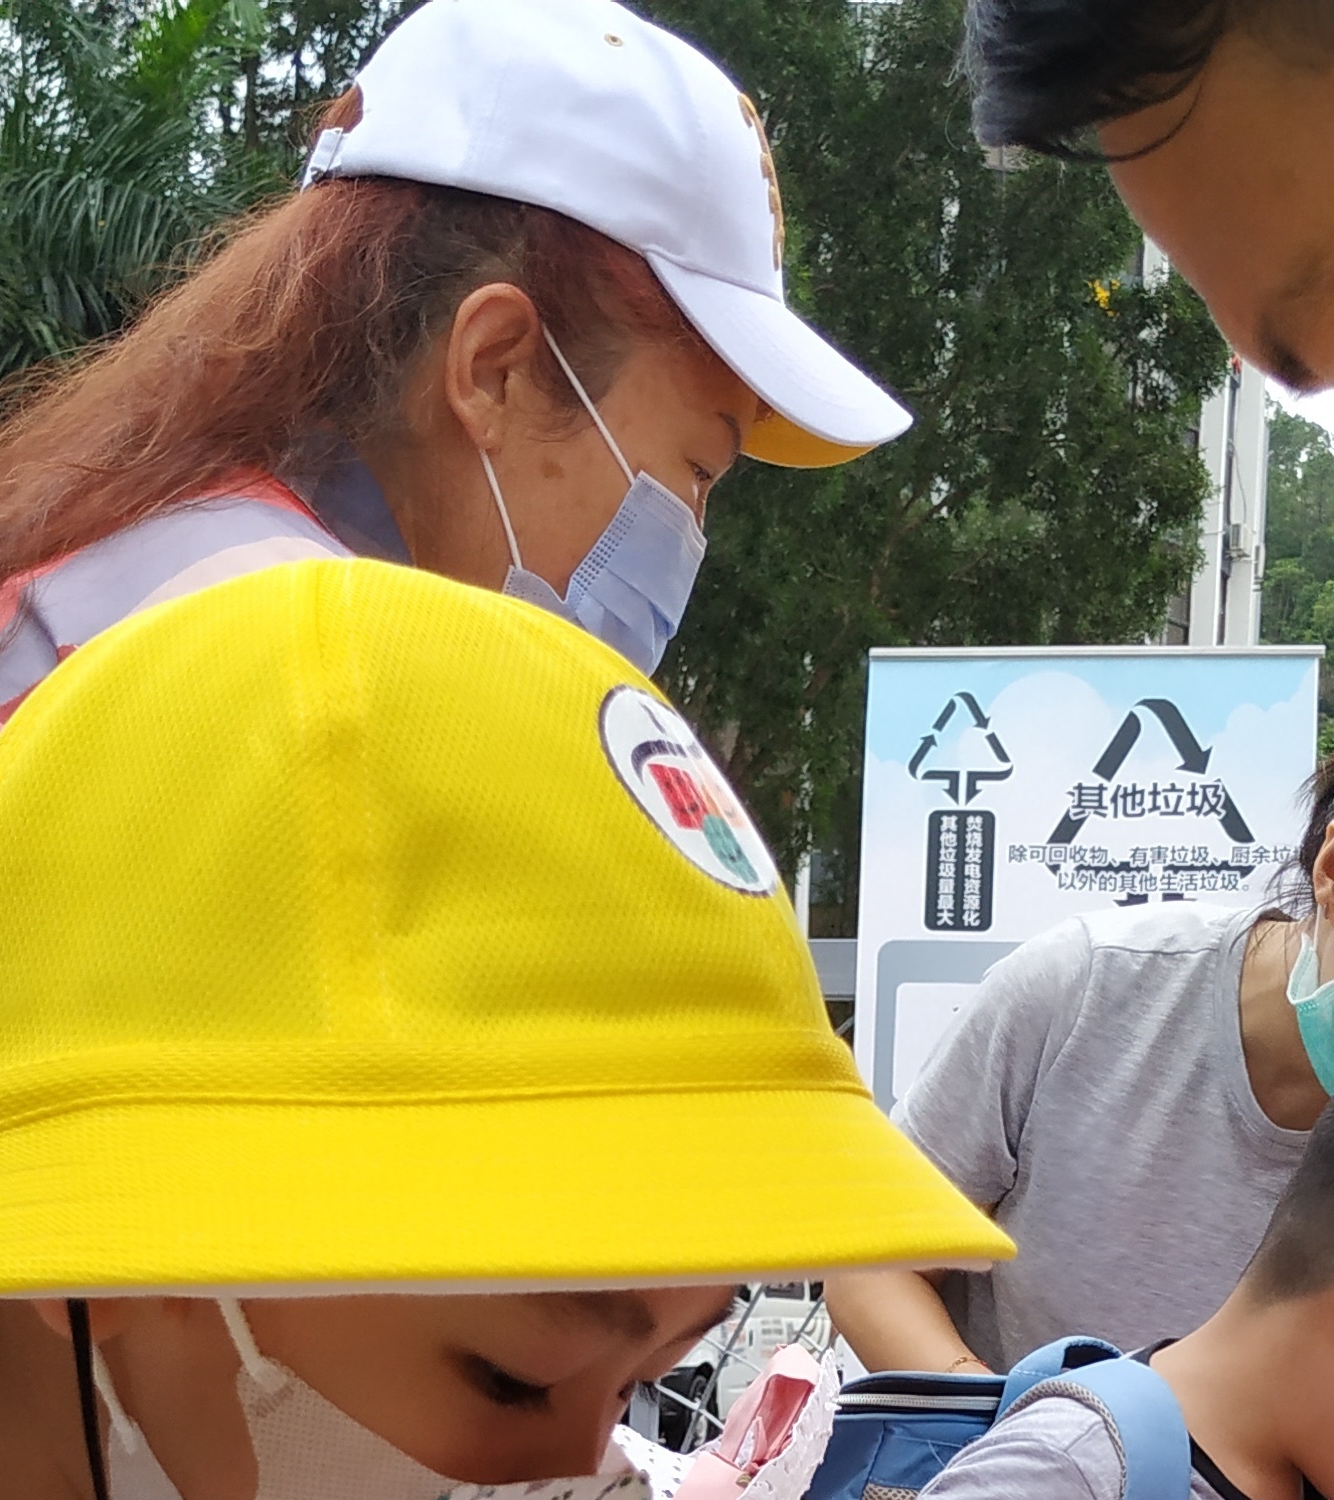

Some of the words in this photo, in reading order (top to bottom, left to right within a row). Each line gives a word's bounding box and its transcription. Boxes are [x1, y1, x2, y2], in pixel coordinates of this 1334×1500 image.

[1071, 782, 1227, 820] 其他垃圾
[936, 815, 958, 926] 其他垃圾量最大
[1058, 871, 1251, 893] 以外的其他生活垃圾。
